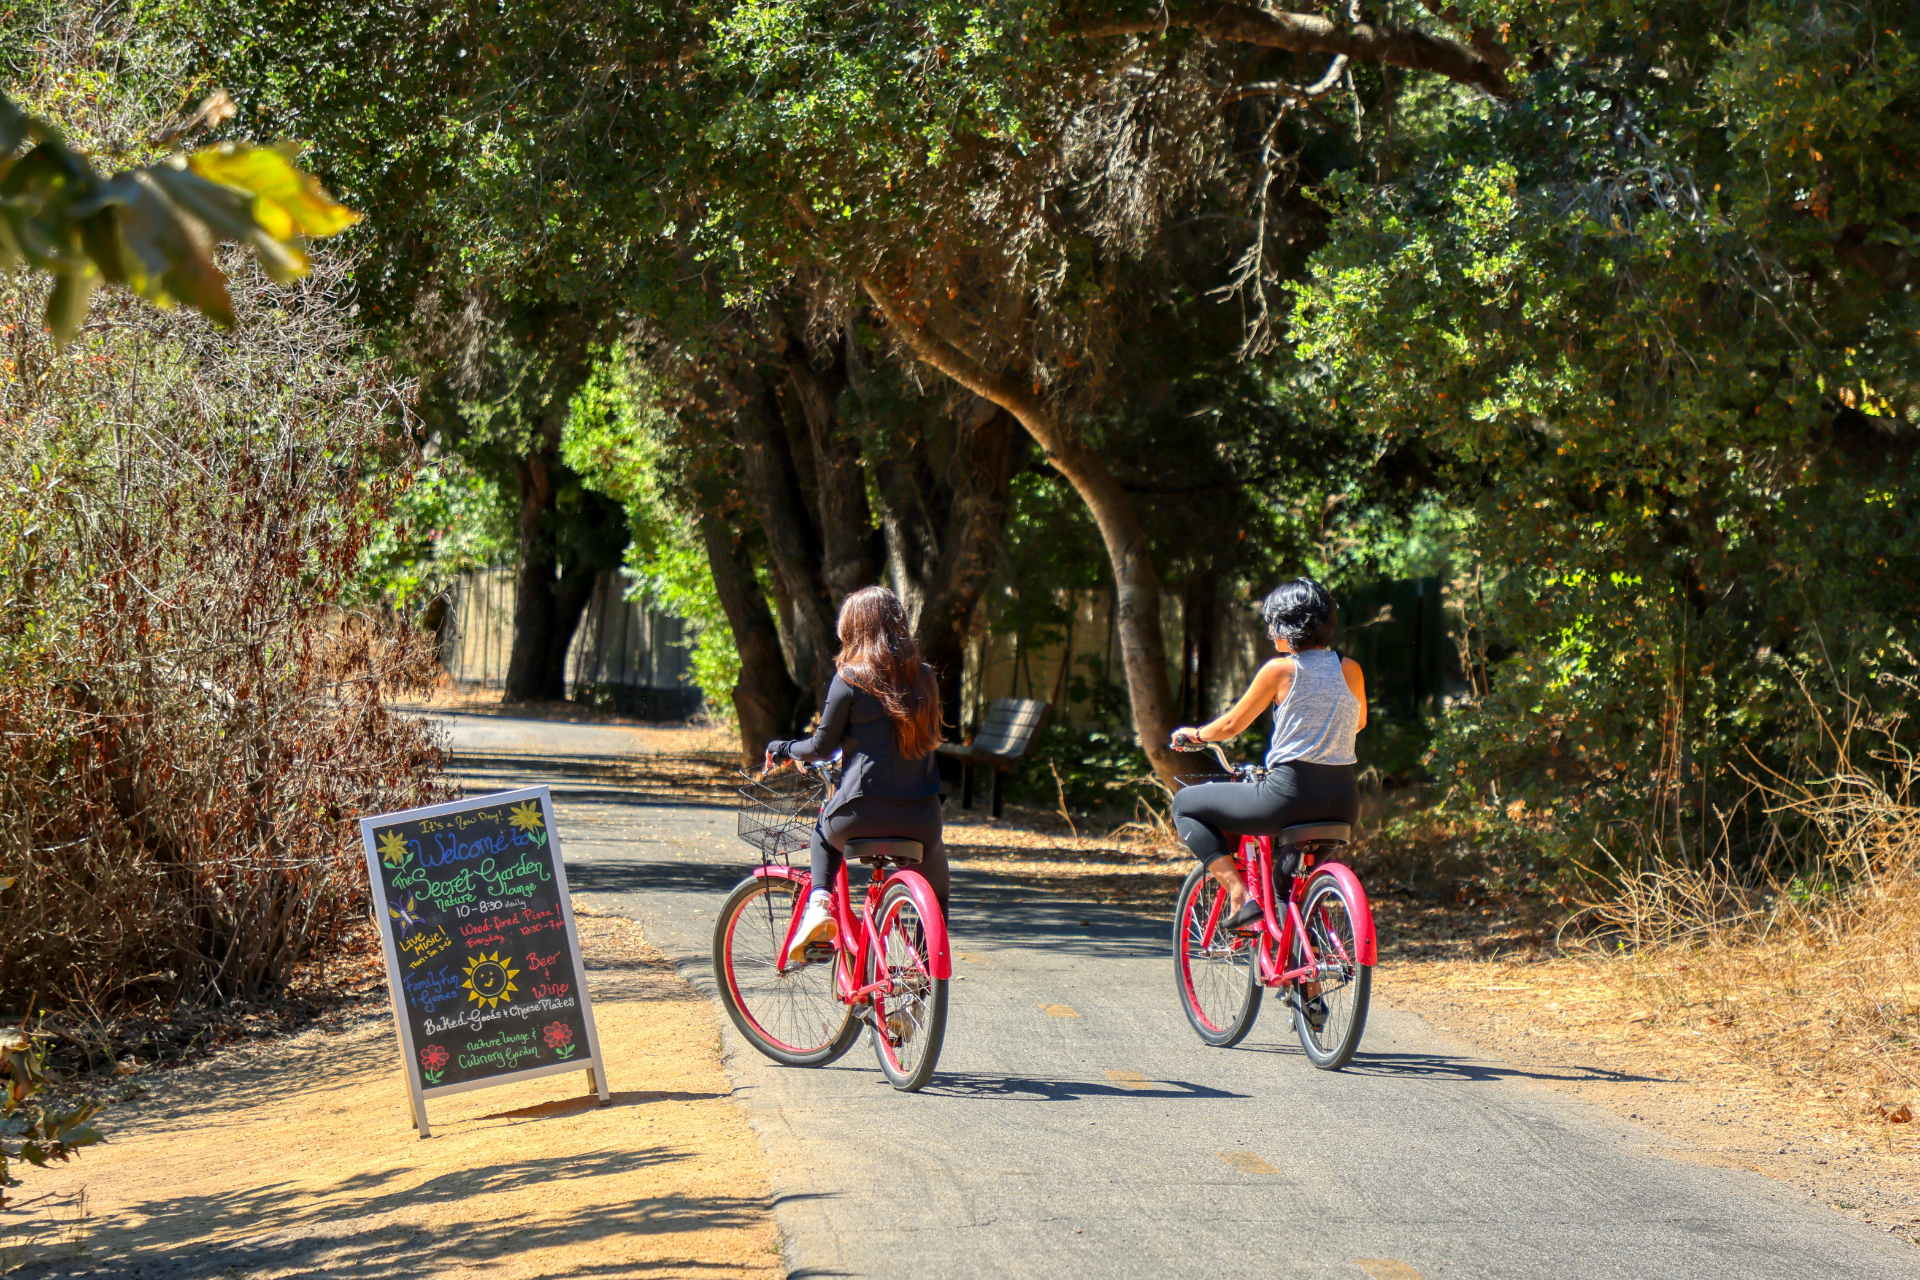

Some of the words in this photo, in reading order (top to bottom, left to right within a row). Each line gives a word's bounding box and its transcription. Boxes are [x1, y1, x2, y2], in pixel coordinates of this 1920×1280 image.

[419, 820, 444, 834] It's
[455, 816, 477, 830] New
[478, 809, 504, 824] Day!
[408, 833, 509, 867] Welcome
[508, 828, 530, 846] to
[392, 871, 413, 891] The
[412, 868, 476, 900] Secret
[473, 853, 551, 896] Garden
[456, 900, 503, 918] 10-8:30
[505, 899, 526, 909] daily
[460, 913, 520, 936] Wood-fired
[399, 932, 426, 952] Live
[466, 934, 505, 948] Everyday
[526, 950, 561, 971] Beer
[403, 971, 442, 993] Family
[439, 964, 460, 989] Fun
[418, 990, 458, 1013] Games
[531, 983, 569, 999] Wine
[509, 1003, 541, 1019] Cheese
[539, 998, 575, 1012] Plates
[458, 1051, 505, 1069] Culinary
